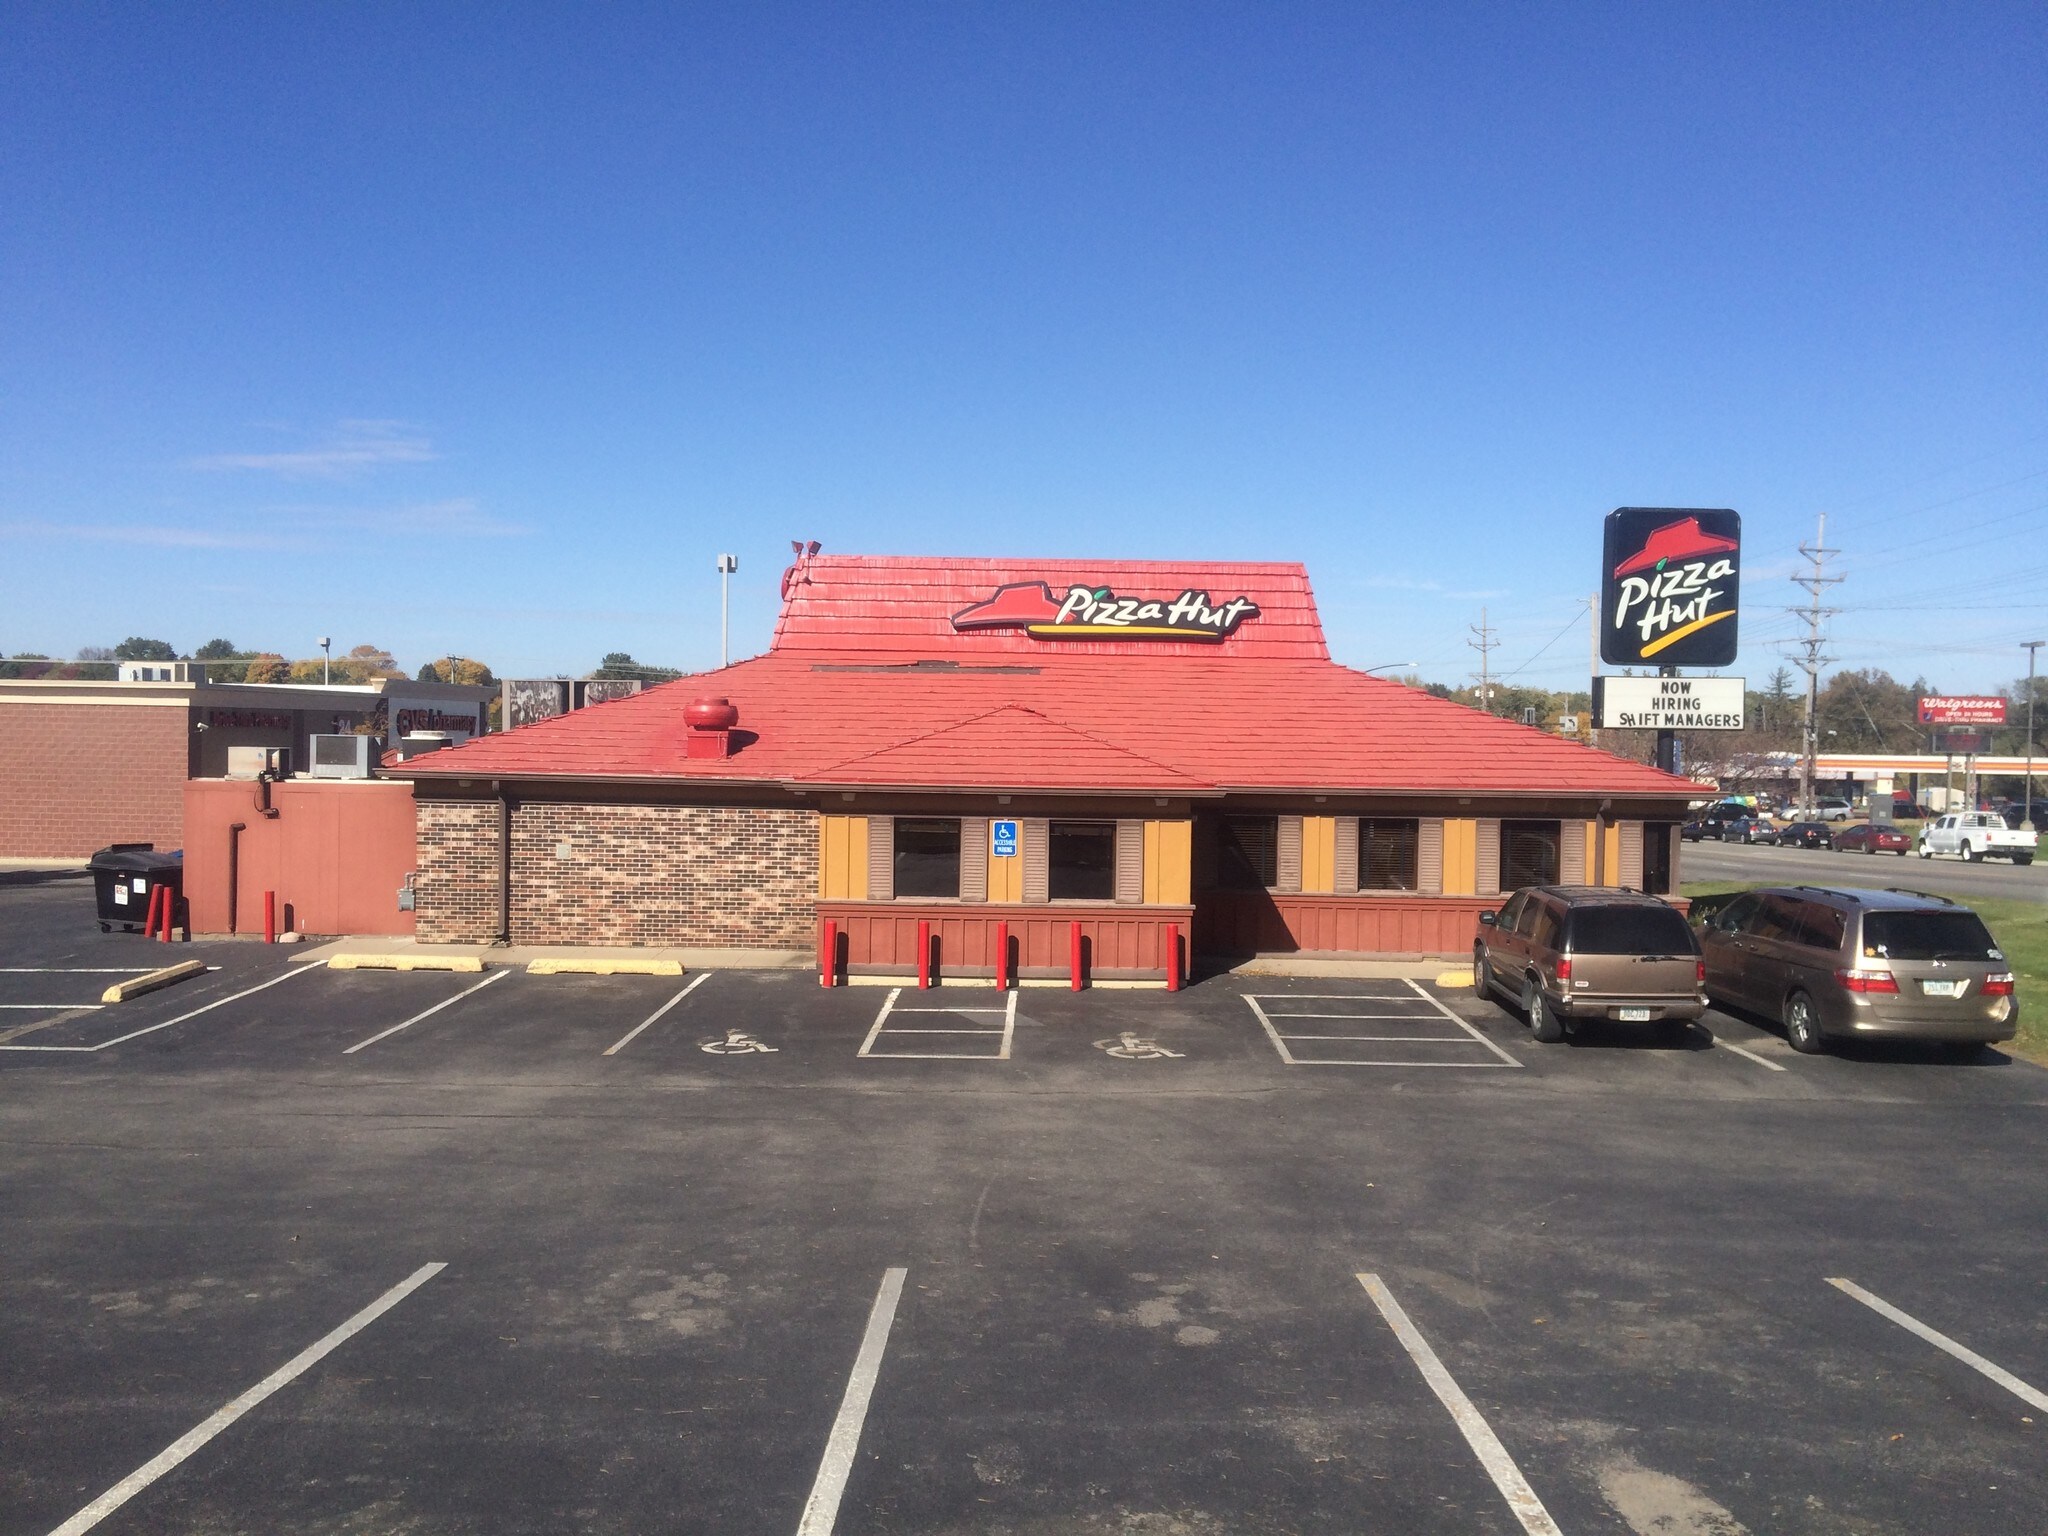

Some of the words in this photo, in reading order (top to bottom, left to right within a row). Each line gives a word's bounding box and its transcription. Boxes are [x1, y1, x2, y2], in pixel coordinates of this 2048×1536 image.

[1616, 557, 1736, 629] Pizza
[1056, 588, 1163, 625] Pizza
[1167, 591, 1255, 627] Hut
[1637, 587, 1724, 641] Hut
[1660, 681, 1691, 694] NOW
[1652, 697, 1701, 710] HIRING
[1922, 698, 2003, 711] Walgreens
[1619, 713, 1660, 727] SHIFT
[1664, 713, 1741, 727] MANAGERS
